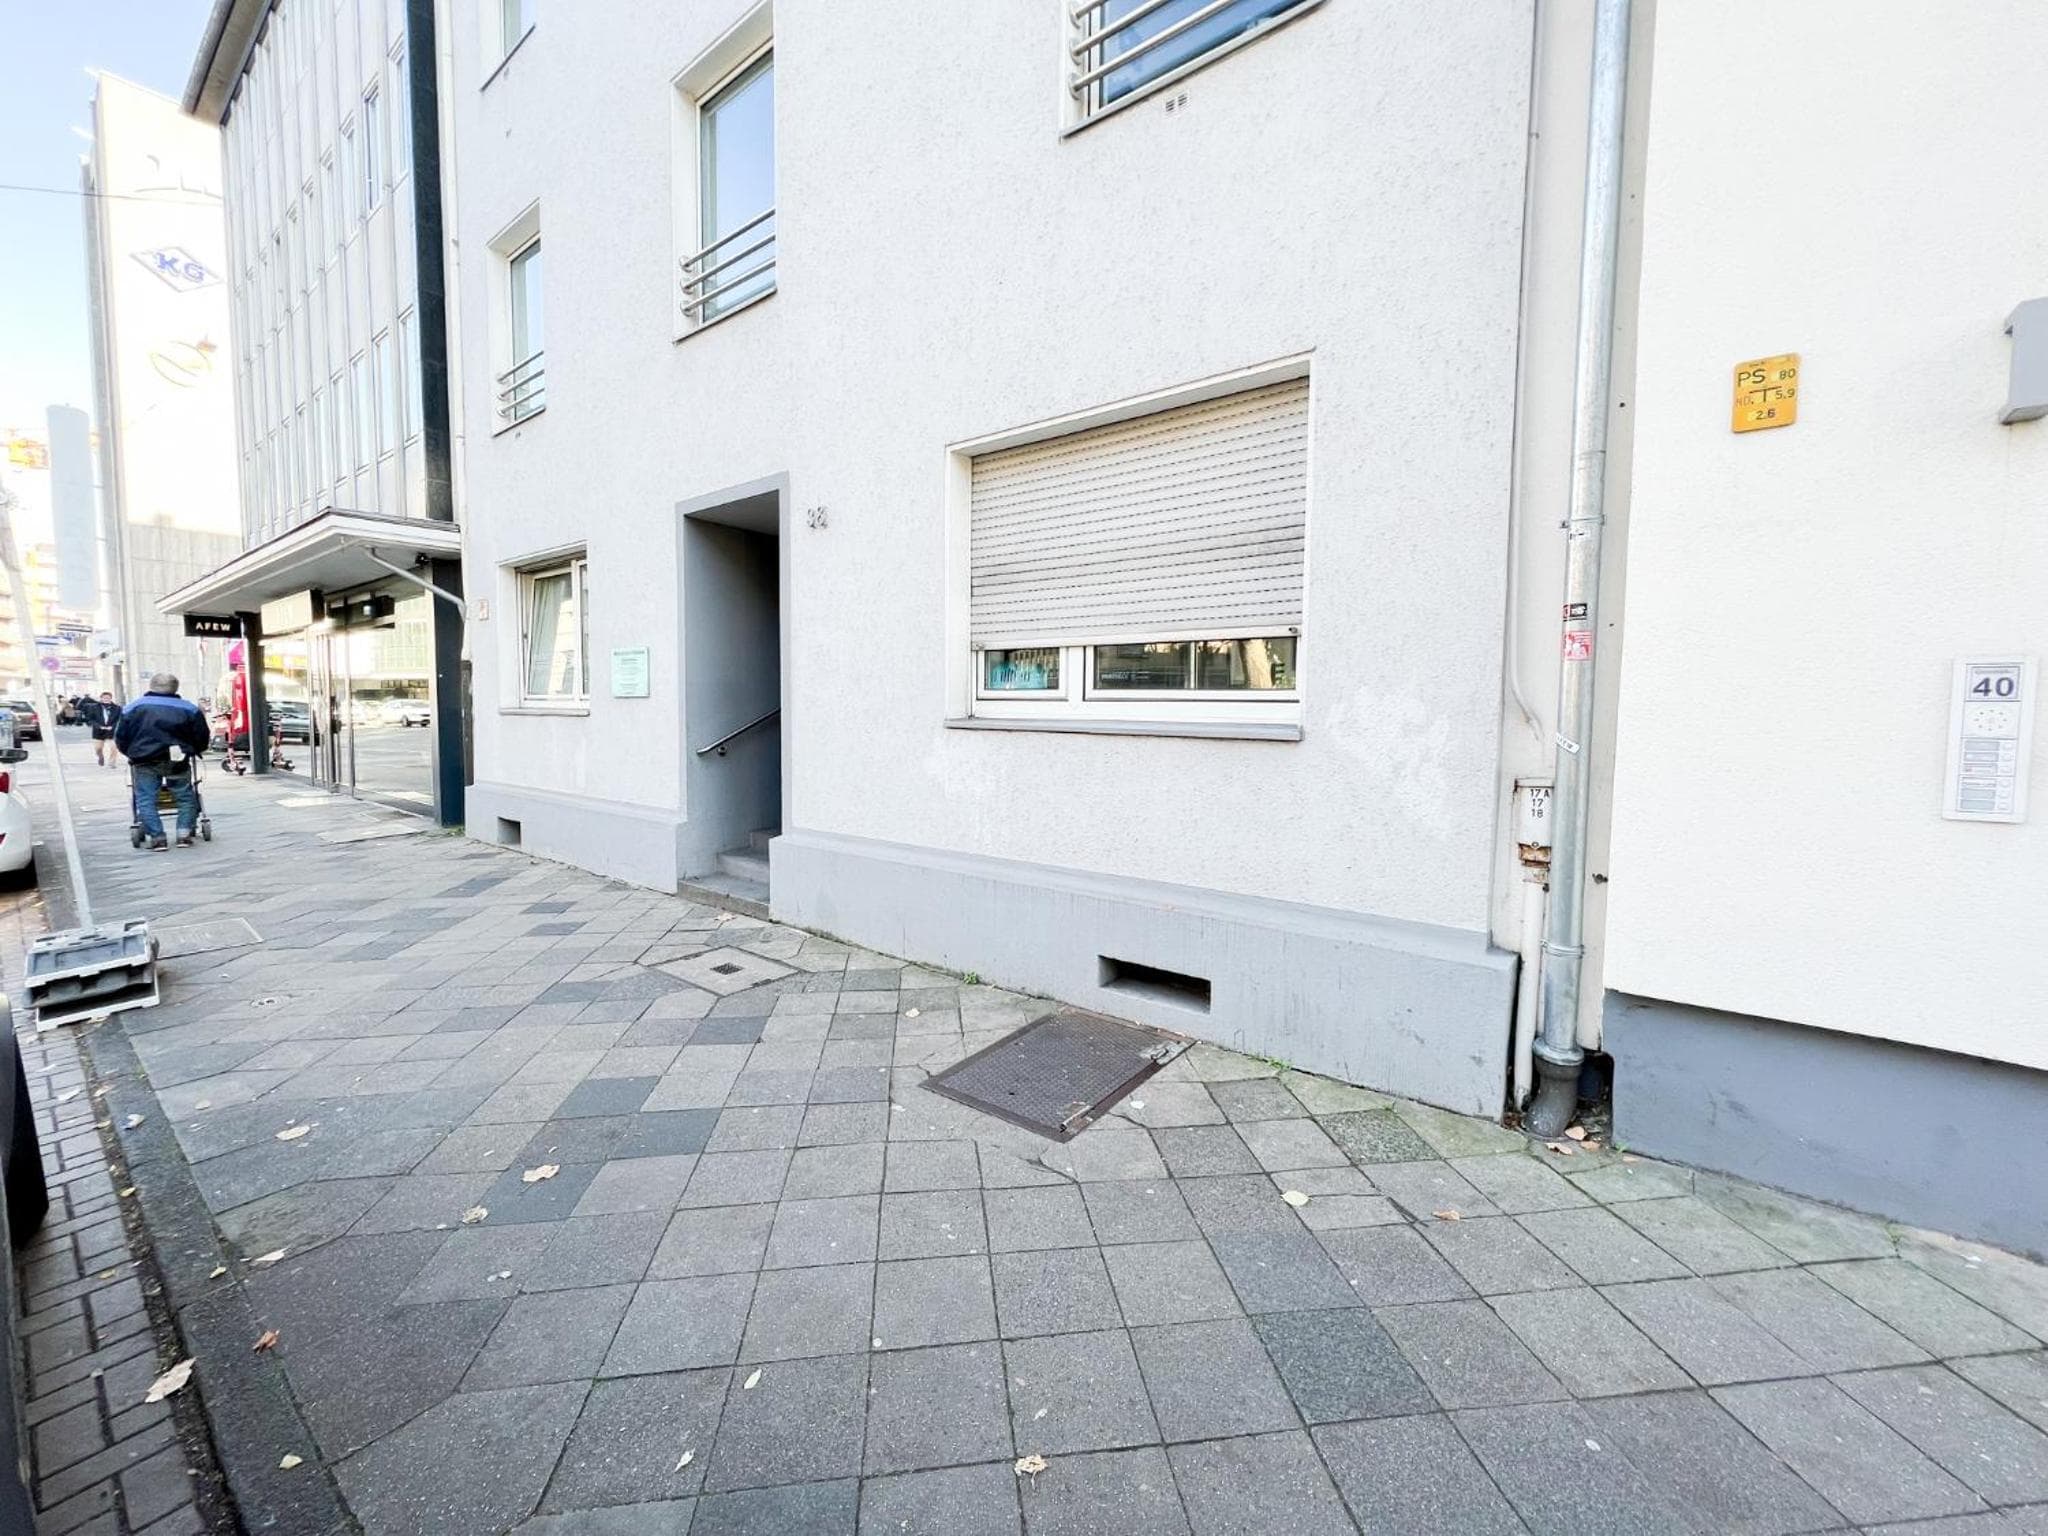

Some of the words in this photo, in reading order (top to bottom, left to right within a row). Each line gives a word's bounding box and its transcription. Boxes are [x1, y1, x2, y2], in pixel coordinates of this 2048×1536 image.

[1737, 368, 1766, 387] PS
[196, 622, 231, 631] AFEW
[1973, 677, 2014, 697] 40
[1532, 798, 1544, 807] 17
